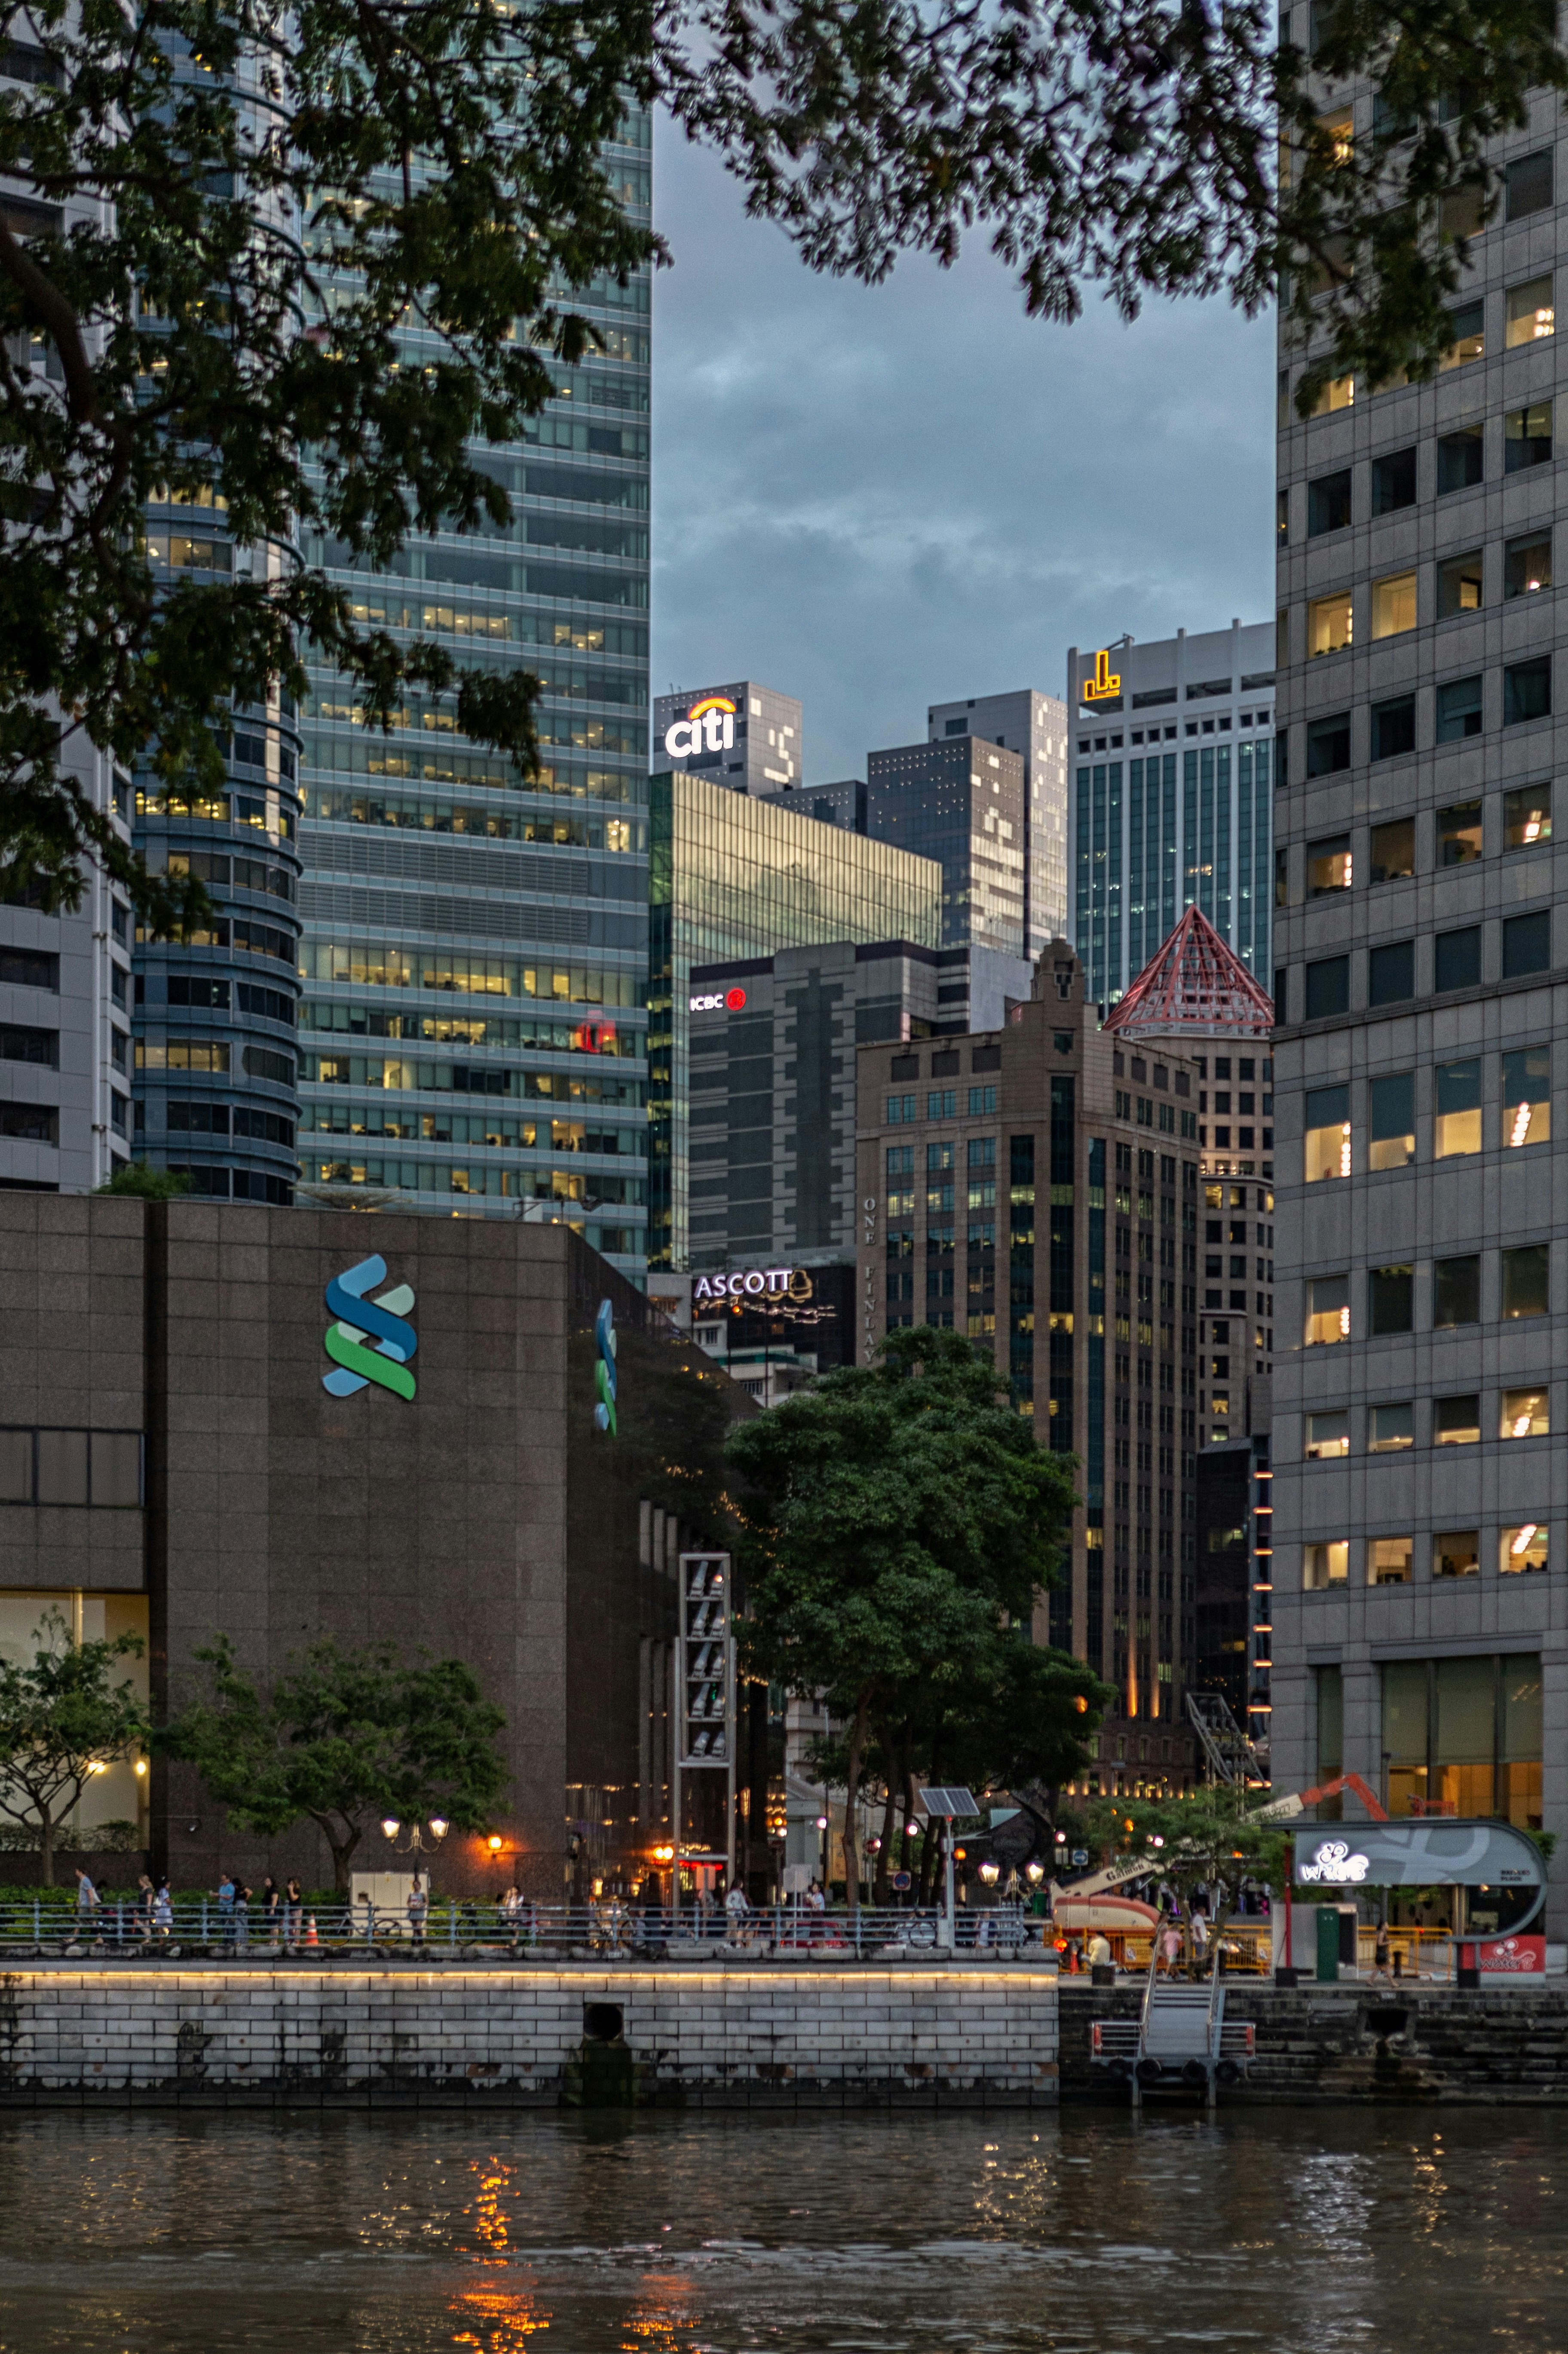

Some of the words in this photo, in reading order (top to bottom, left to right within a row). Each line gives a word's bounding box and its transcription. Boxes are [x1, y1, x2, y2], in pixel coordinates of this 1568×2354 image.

[665, 707, 734, 758] citi
[690, 994, 723, 1011] ICBC
[864, 1198, 876, 1244] ONE
[694, 1269, 793, 1298] ASCOTT
[864, 1266, 876, 1363] FINLAY
